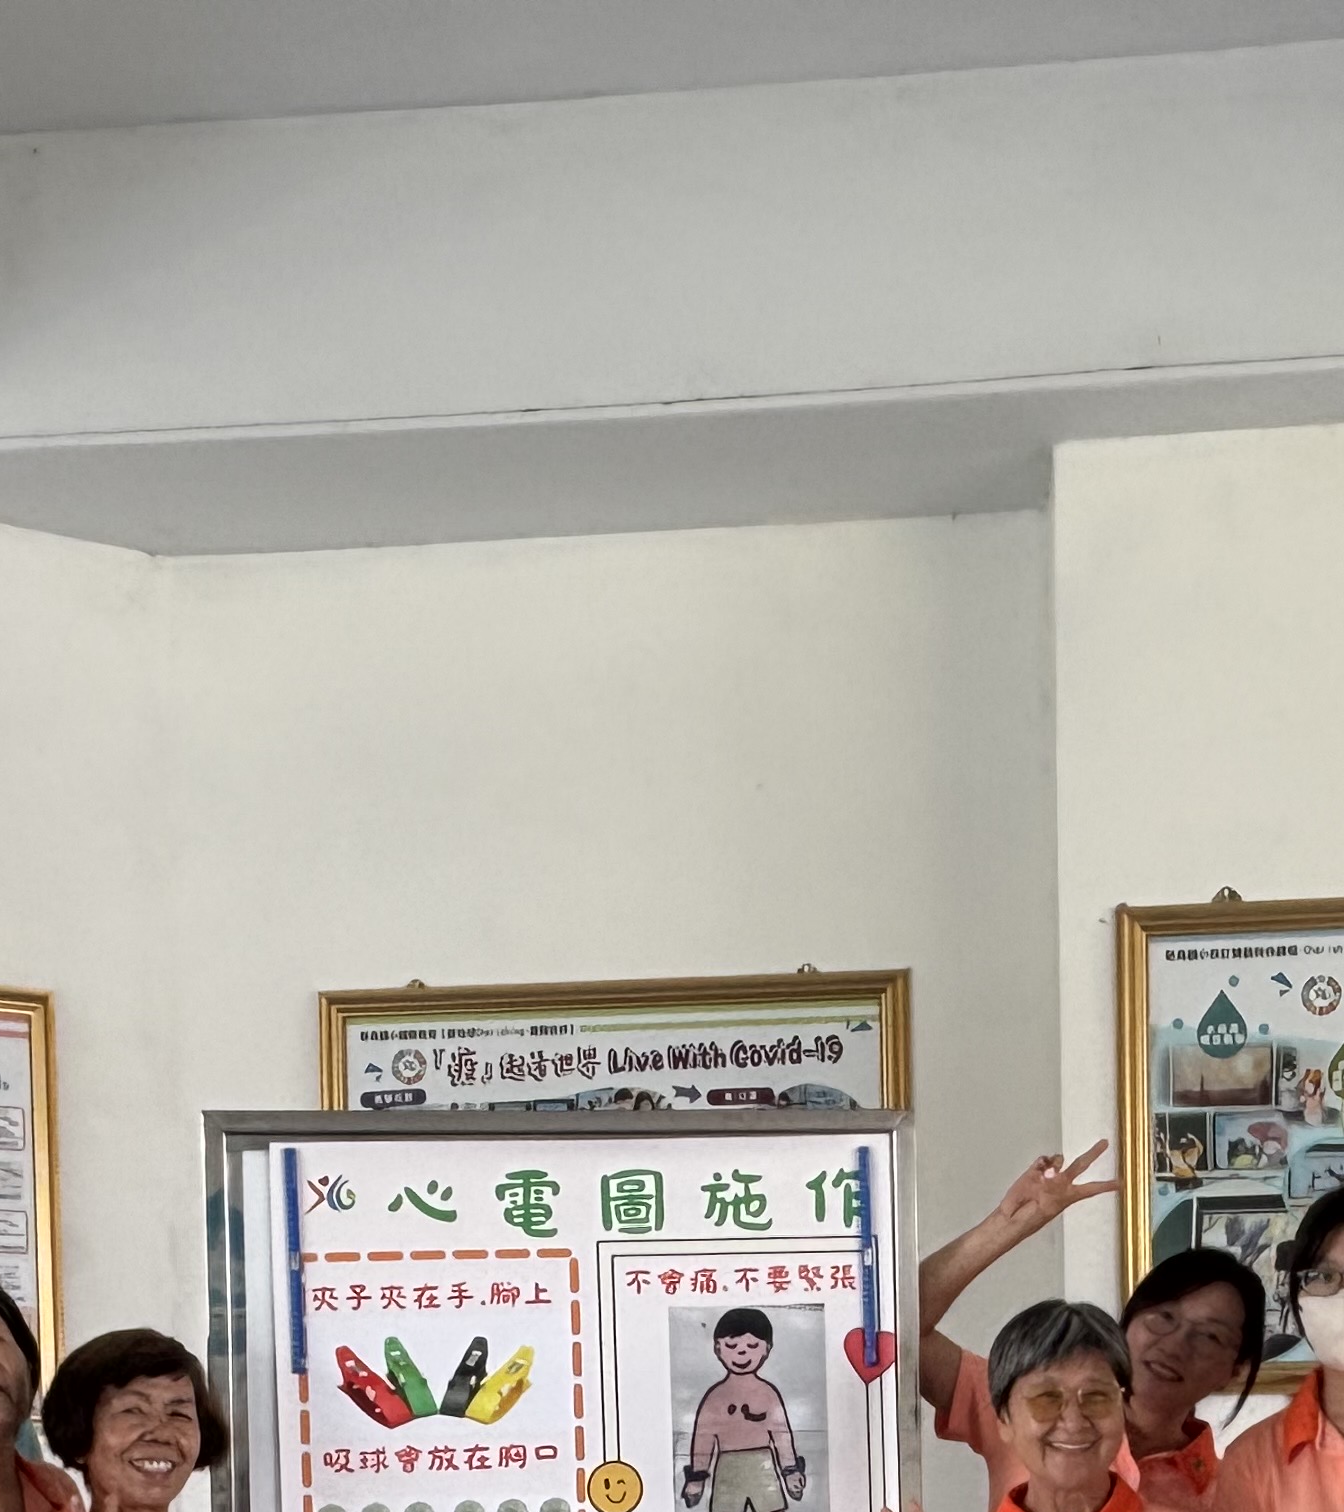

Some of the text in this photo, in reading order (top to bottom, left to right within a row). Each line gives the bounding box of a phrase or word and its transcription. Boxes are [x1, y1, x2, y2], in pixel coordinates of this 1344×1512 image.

[607, 1047, 664, 1075] Live
[667, 1041, 727, 1071] With
[386, 1168, 863, 1238] 心電圖施作
[323, 1443, 559, 1474] 吸球會放在胸口
